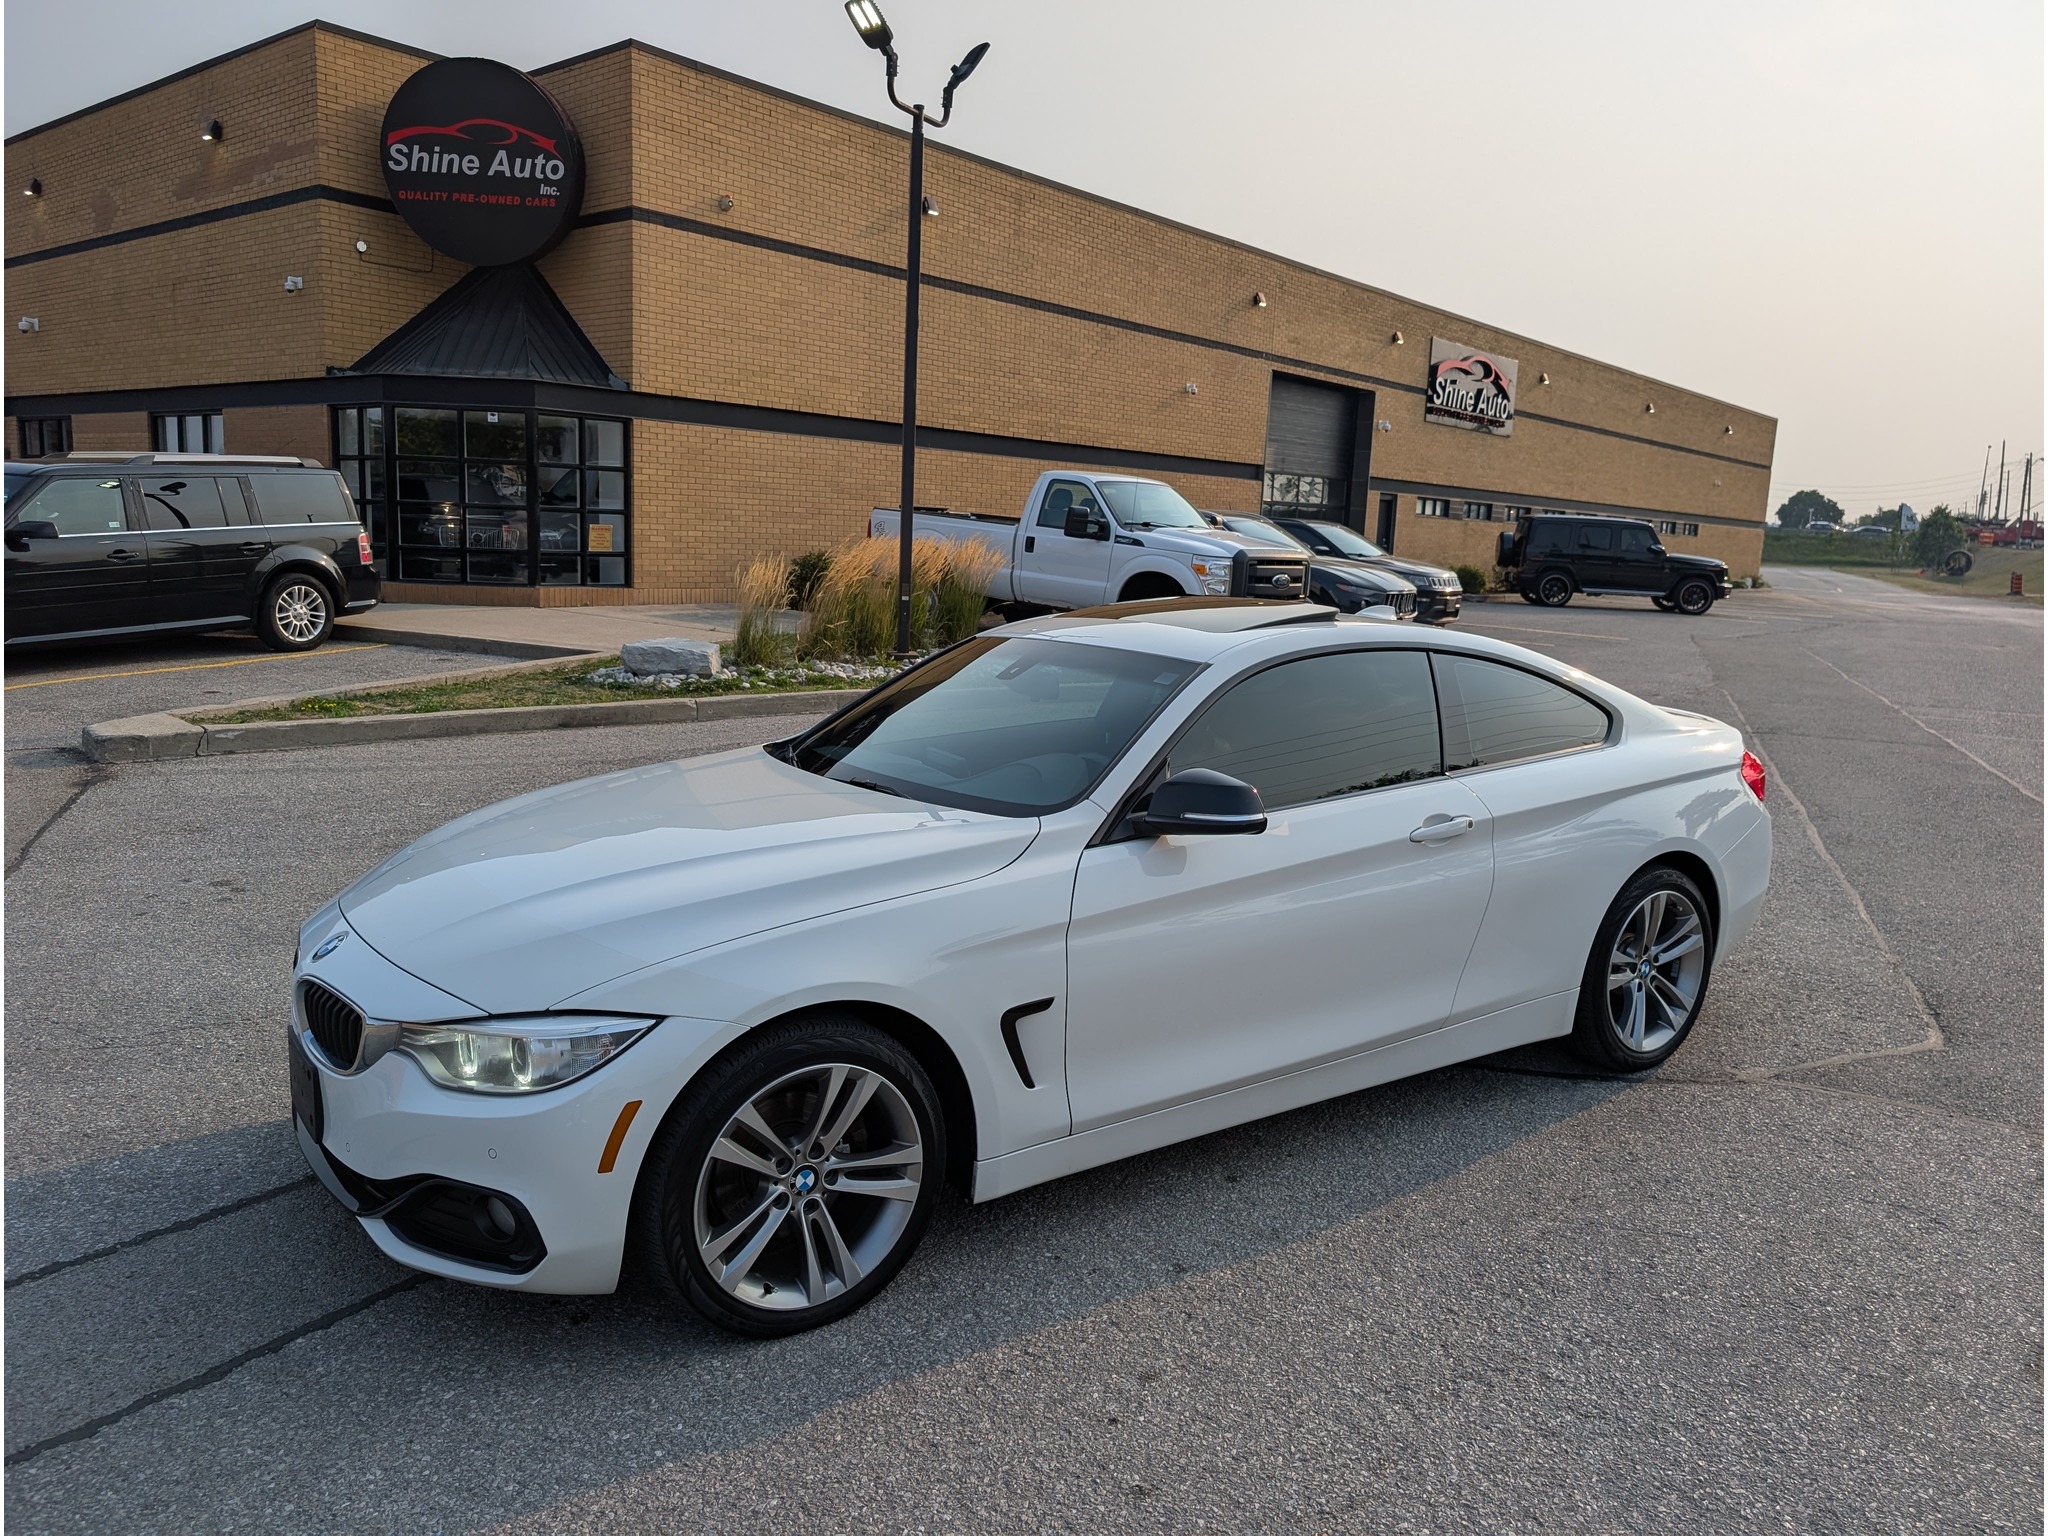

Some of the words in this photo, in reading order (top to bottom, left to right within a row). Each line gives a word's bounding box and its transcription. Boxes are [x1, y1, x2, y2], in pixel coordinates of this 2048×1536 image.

[388, 144, 480, 175] Shine
[488, 150, 565, 180] Auto
[399, 190, 448, 201] QUALITY
[453, 193, 520, 205] PRE-OWNED
[526, 197, 556, 207] CARS
[540, 184, 560, 196] Inc.
[1433, 377, 1475, 412] Shine
[1476, 387, 1509, 419] Auto
